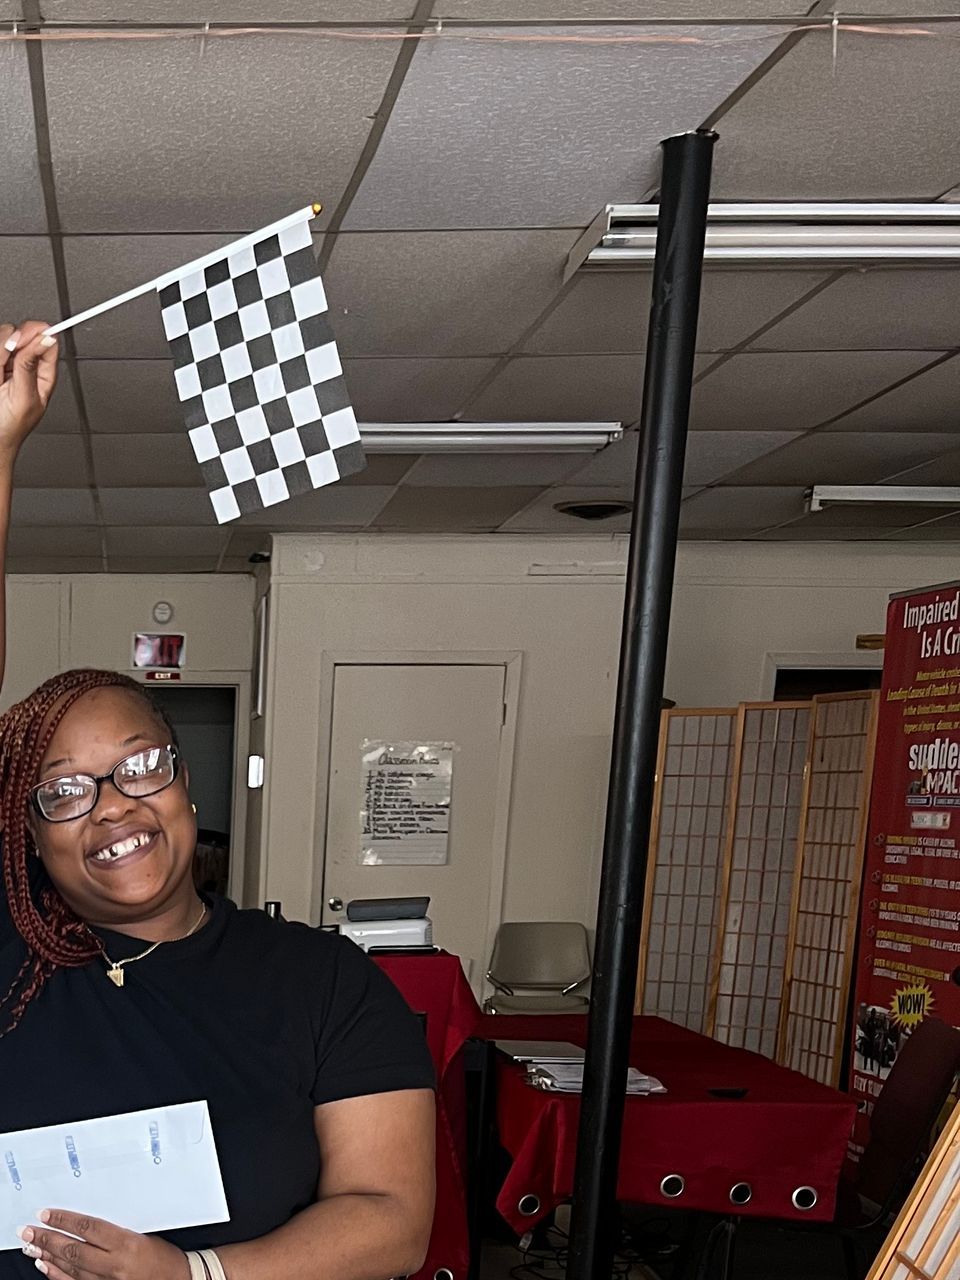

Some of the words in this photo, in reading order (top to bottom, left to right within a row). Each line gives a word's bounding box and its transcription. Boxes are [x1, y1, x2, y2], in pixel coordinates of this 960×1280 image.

[903, 591, 960, 634] Impaired
[920, 631, 932, 658] Is
[933, 628, 941, 657] A
[908, 737, 960, 770] sudde
[898, 993, 926, 1015] WOW!
